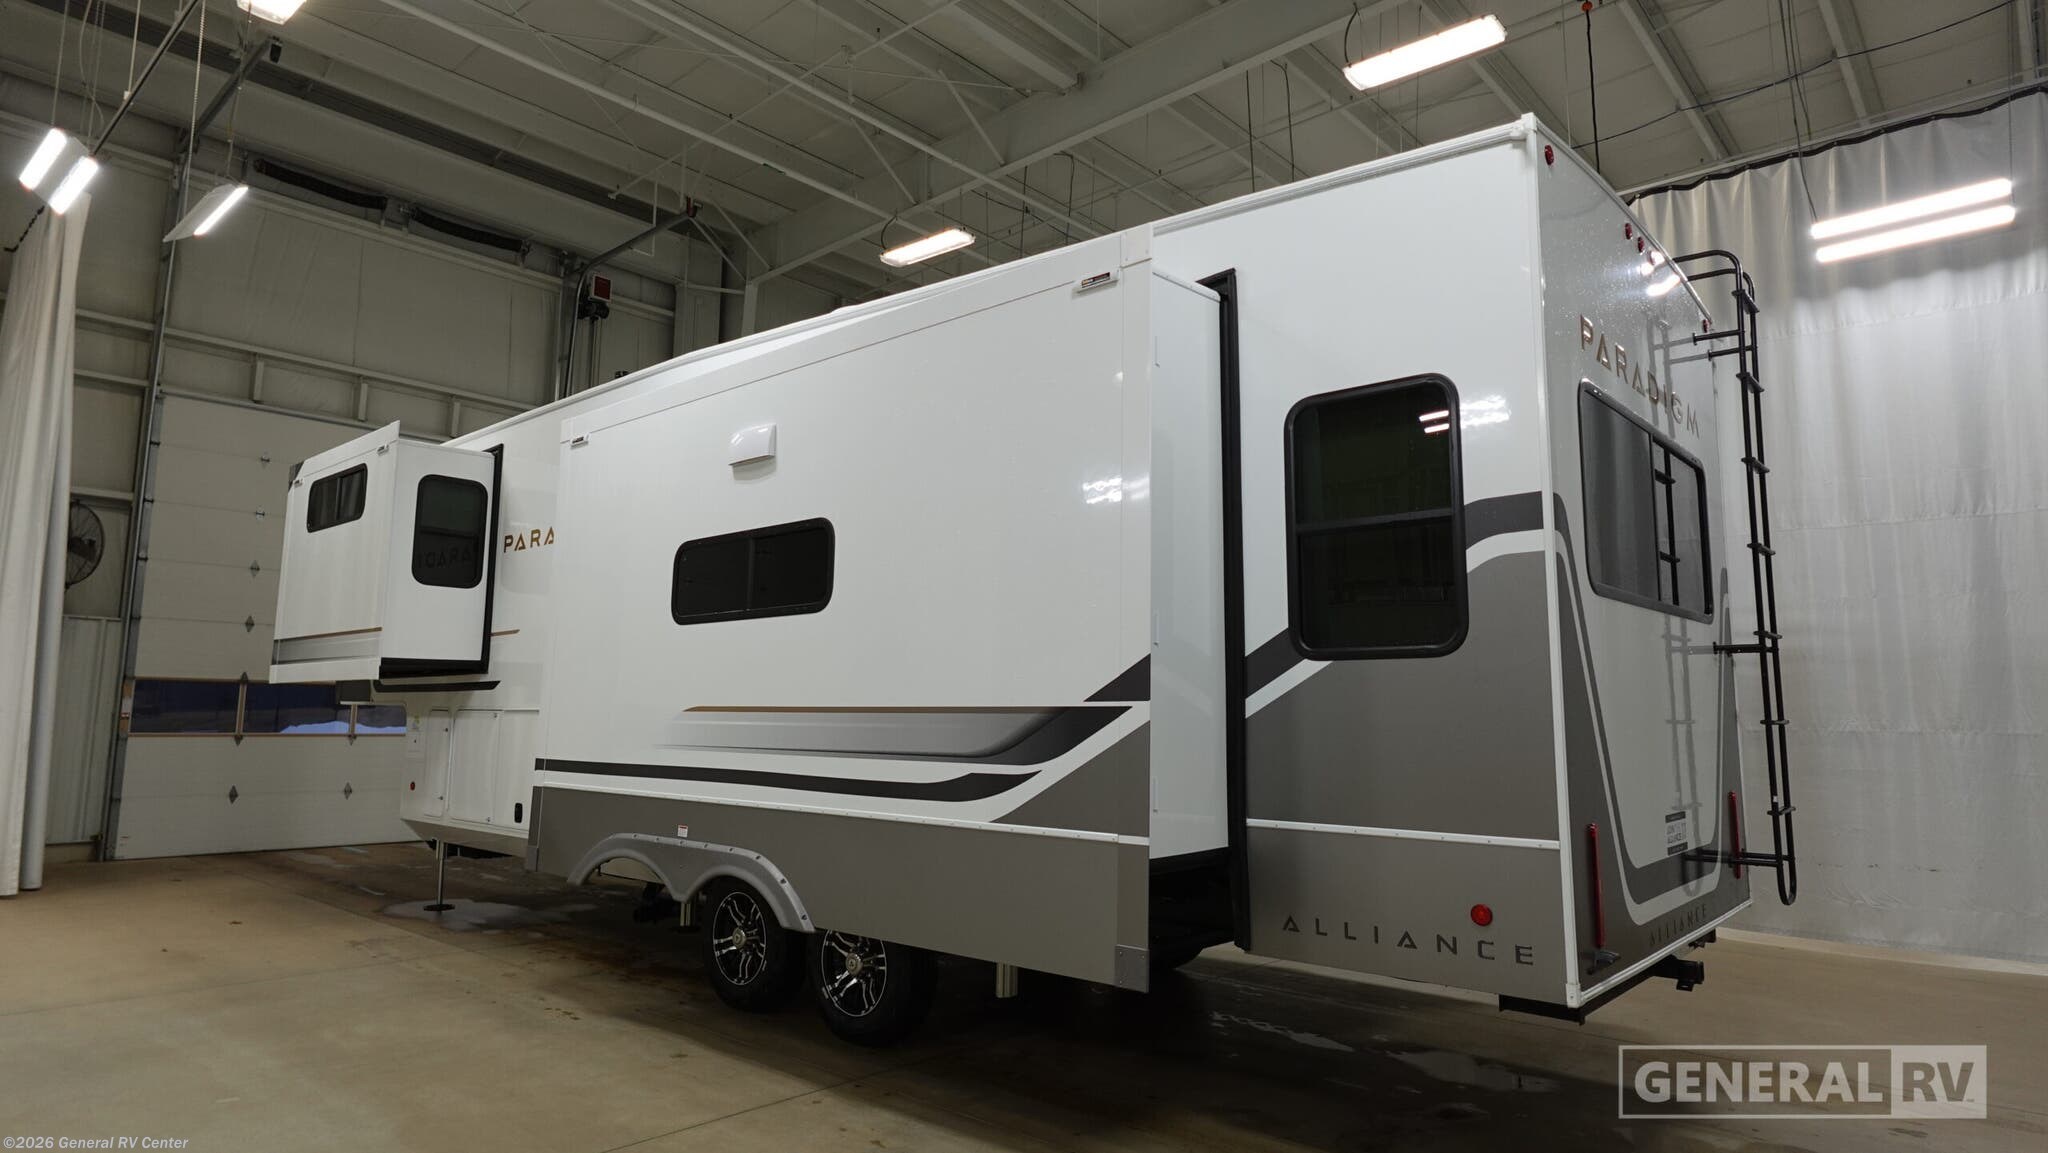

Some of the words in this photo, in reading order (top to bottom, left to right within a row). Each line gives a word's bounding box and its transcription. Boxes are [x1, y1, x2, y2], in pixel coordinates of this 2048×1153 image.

[1580, 314, 1700, 439] PARADIGM
[503, 526, 555, 553] PARA
[1282, 915, 1534, 966] ALLIANCE
[1649, 903, 1707, 946] ALLIANCE
